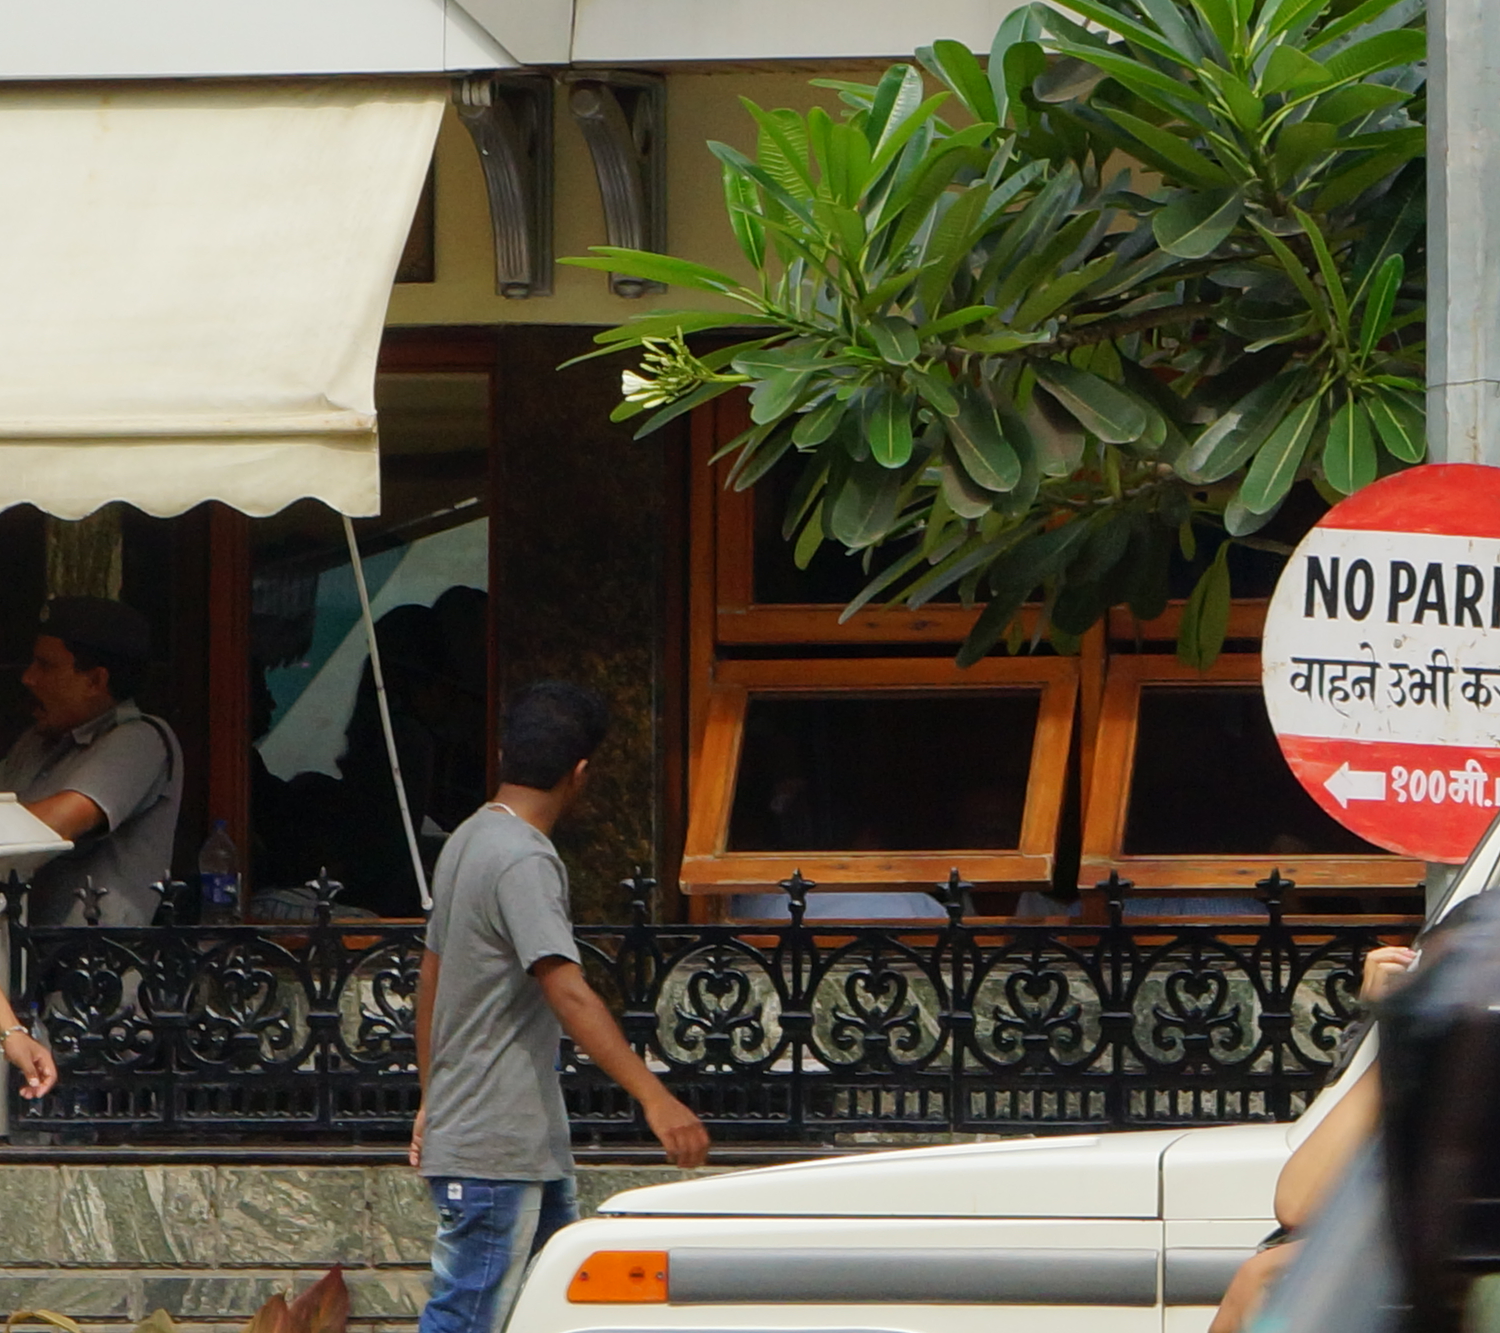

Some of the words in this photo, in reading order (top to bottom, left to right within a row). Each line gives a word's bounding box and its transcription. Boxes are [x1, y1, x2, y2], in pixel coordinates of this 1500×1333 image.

[1303, 555, 1375, 622] NO
[1290, 641, 1382, 718] वाहने
[1387, 648, 1455, 711] उभी
